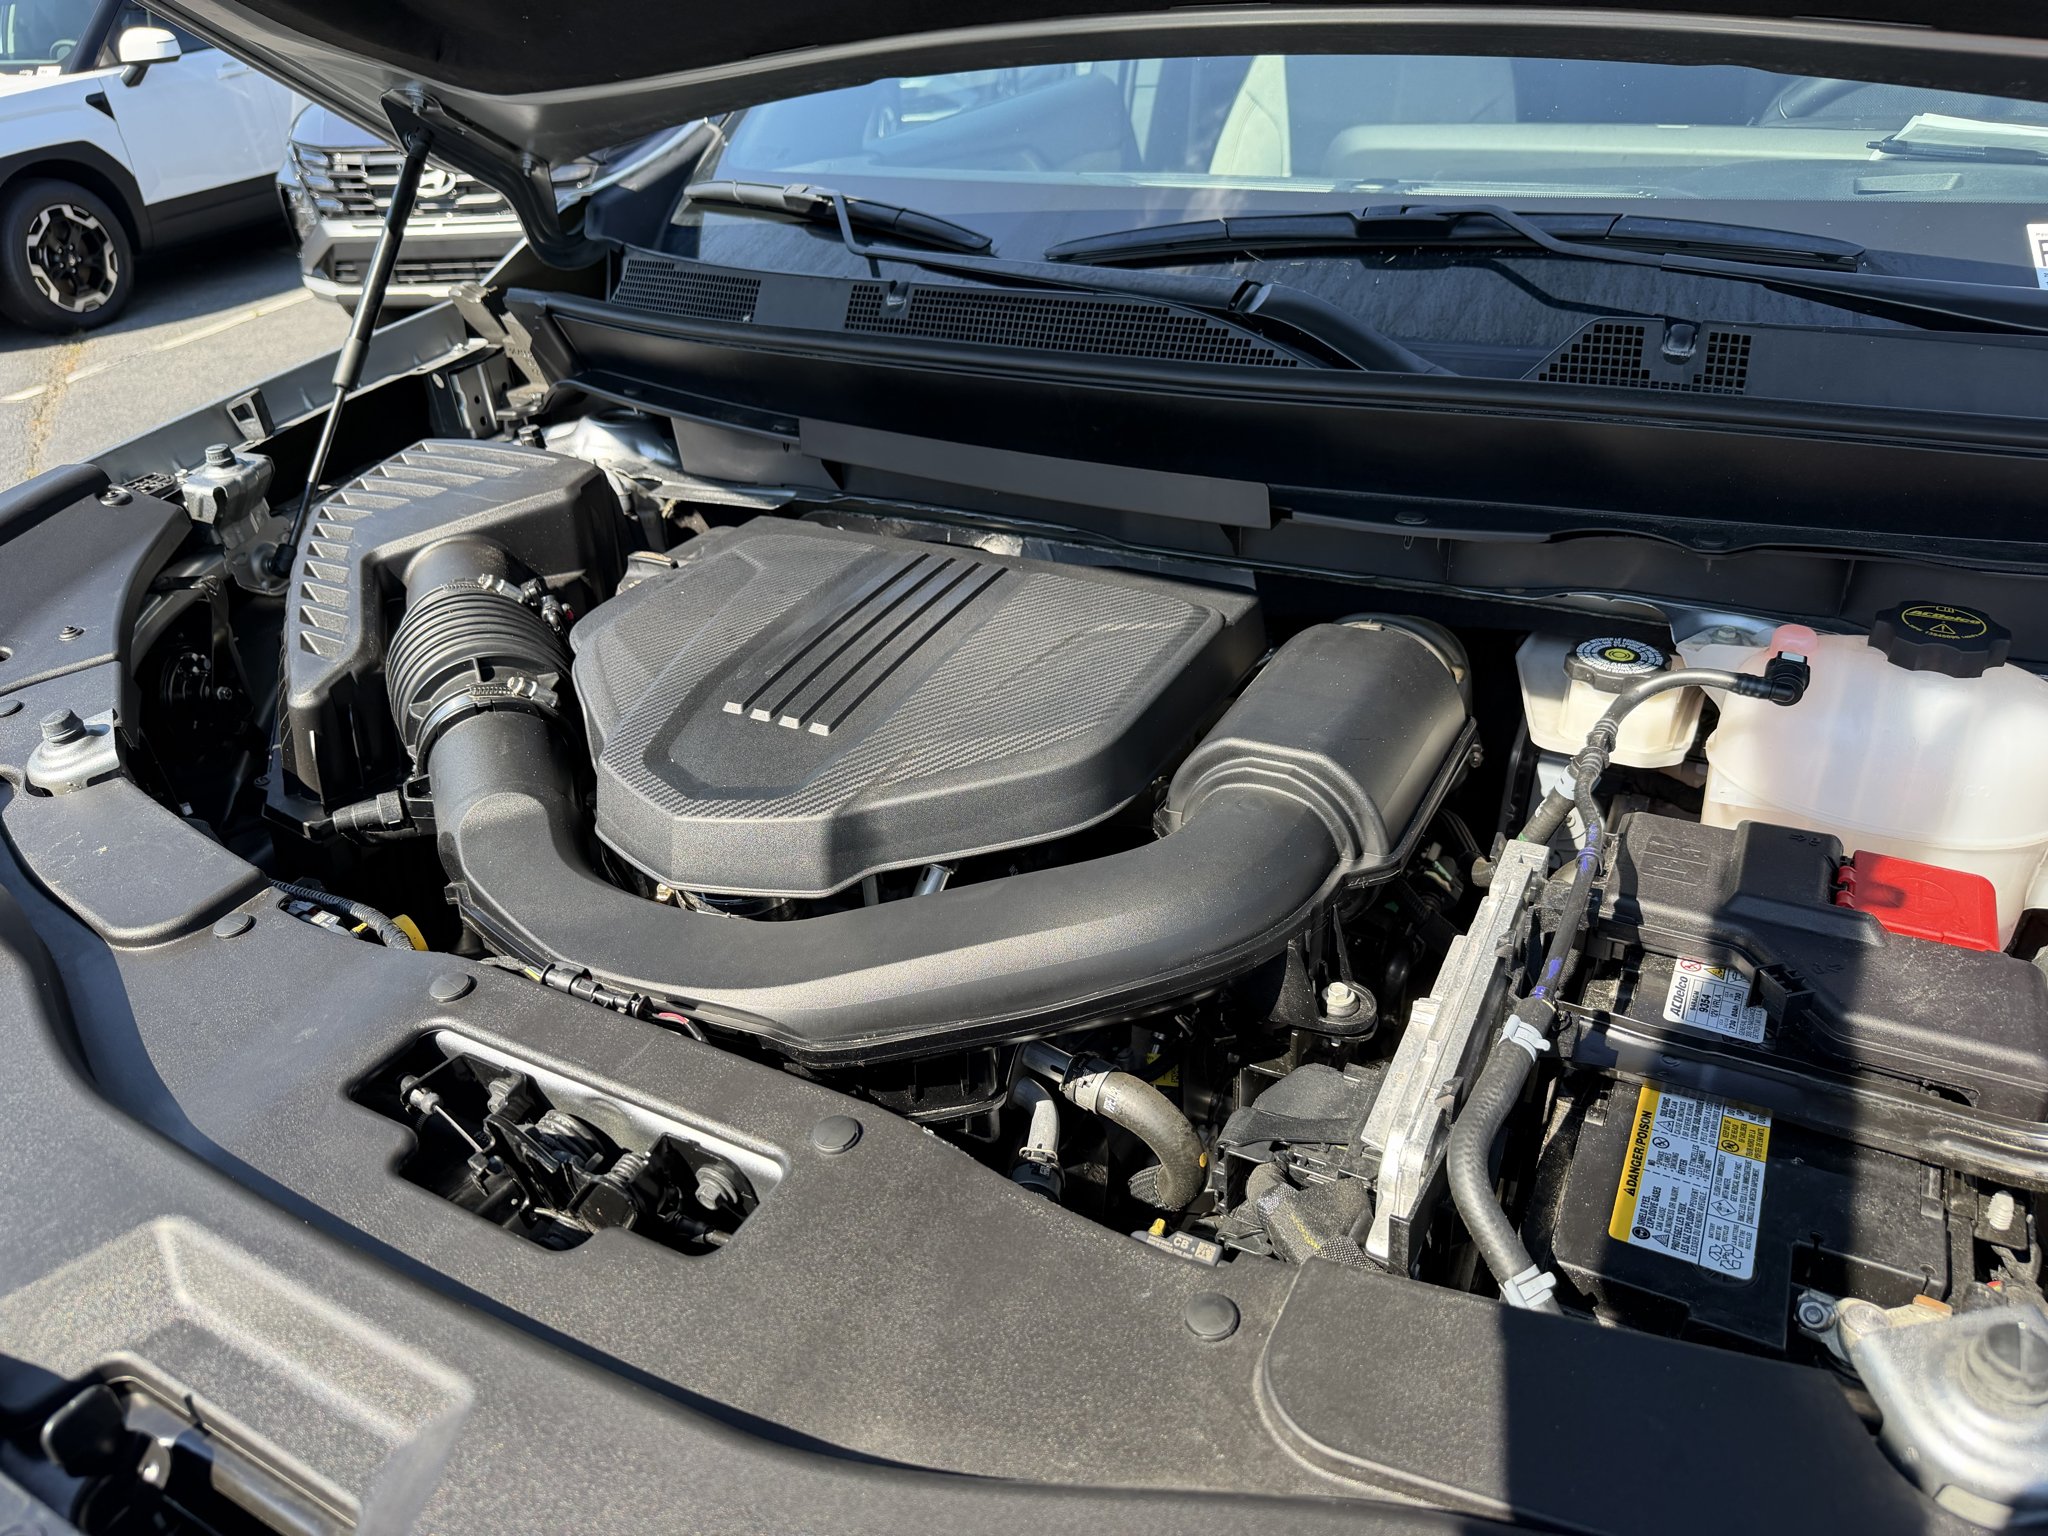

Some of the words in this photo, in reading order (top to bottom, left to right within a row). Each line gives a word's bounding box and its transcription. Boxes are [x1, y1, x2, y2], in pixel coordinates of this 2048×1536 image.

[1906, 610, 1981, 624] ACDelco
[1670, 976, 1688, 1016] ACDelco
[1712, 994, 1722, 1008] VRLA
[1699, 994, 1711, 1013] 9354
[1660, 1097, 1670, 1117] SULFURIC
[1668, 1109, 1676, 1119] ACID
[1677, 1101, 1686, 1122] BLINDNESS
[1674, 1122, 1682, 1135] CAUSE
[1683, 1116, 1692, 1131] SEVERE
[1702, 1116, 1710, 1132] CAUSER
[1731, 1124, 1739, 1134] REACH
[1739, 1123, 1747, 1138] CHILDREN
[1700, 1131, 1708, 1142] PEUT
[1709, 1130, 1717, 1138] DES
[1628, 1110, 1653, 1187] DANGER/POISON
[1655, 1151, 1665, 1165] SPARKS
[1662, 1153, 1671, 1167] FLAMES
[1670, 1152, 1679, 1169] SMOKING
[1697, 1150, 1706, 1169] FLAMMES
[1704, 1159, 1712, 1173] FUMER
[1651, 1186, 1661, 1202] GASES
[1713, 1185, 1721, 1196] FLUSH
[1731, 1181, 1740, 1195] MEDICAL
[1641, 1196, 1650, 1209] EYES.
[1689, 1188, 1698, 1208] PEUVENT
[1646, 1202, 1658, 1228] EXPLOSIVE
[1657, 1206, 1666, 1221] CAUSE
[1677, 1202, 1687, 1215] YEUX.
[1637, 1209, 1647, 1226] SHIELD
[1664, 1209, 1675, 1234] BLINDNESS
[1676, 1216, 1684, 1226] LES
[1684, 1207, 1695, 1233] EXPLOSIFS
[1694, 1211, 1703, 1229] RENDRE
[1655, 1221, 1663, 1231] CAN
[1173, 1237, 1189, 1249] CB
[1682, 1233, 1691, 1244] GAZ
[1680, 1244, 1689, 1254] LES
[1690, 1236, 1699, 1257] BLESSER
